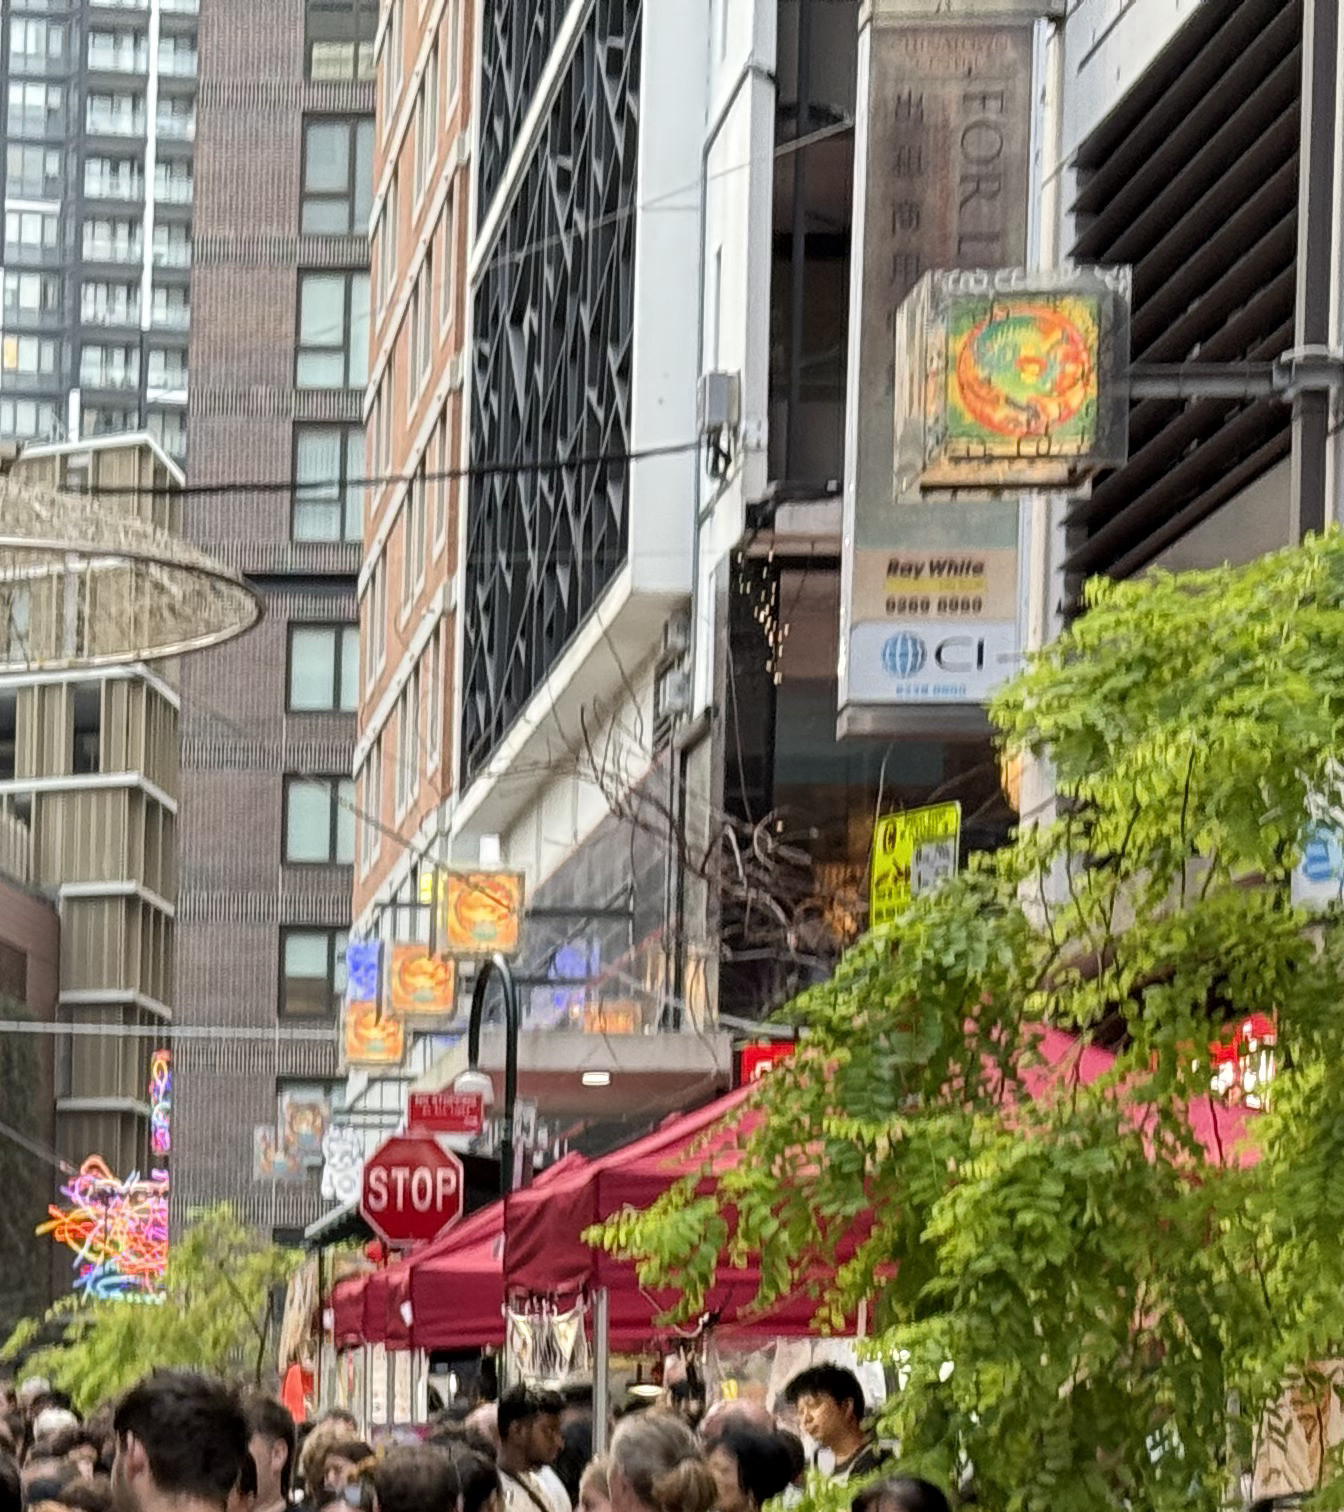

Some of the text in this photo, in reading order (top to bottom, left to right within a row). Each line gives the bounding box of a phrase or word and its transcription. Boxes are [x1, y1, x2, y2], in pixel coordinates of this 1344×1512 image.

[885, 557, 986, 580] Ray White
[368, 1165, 457, 1213] STOP
